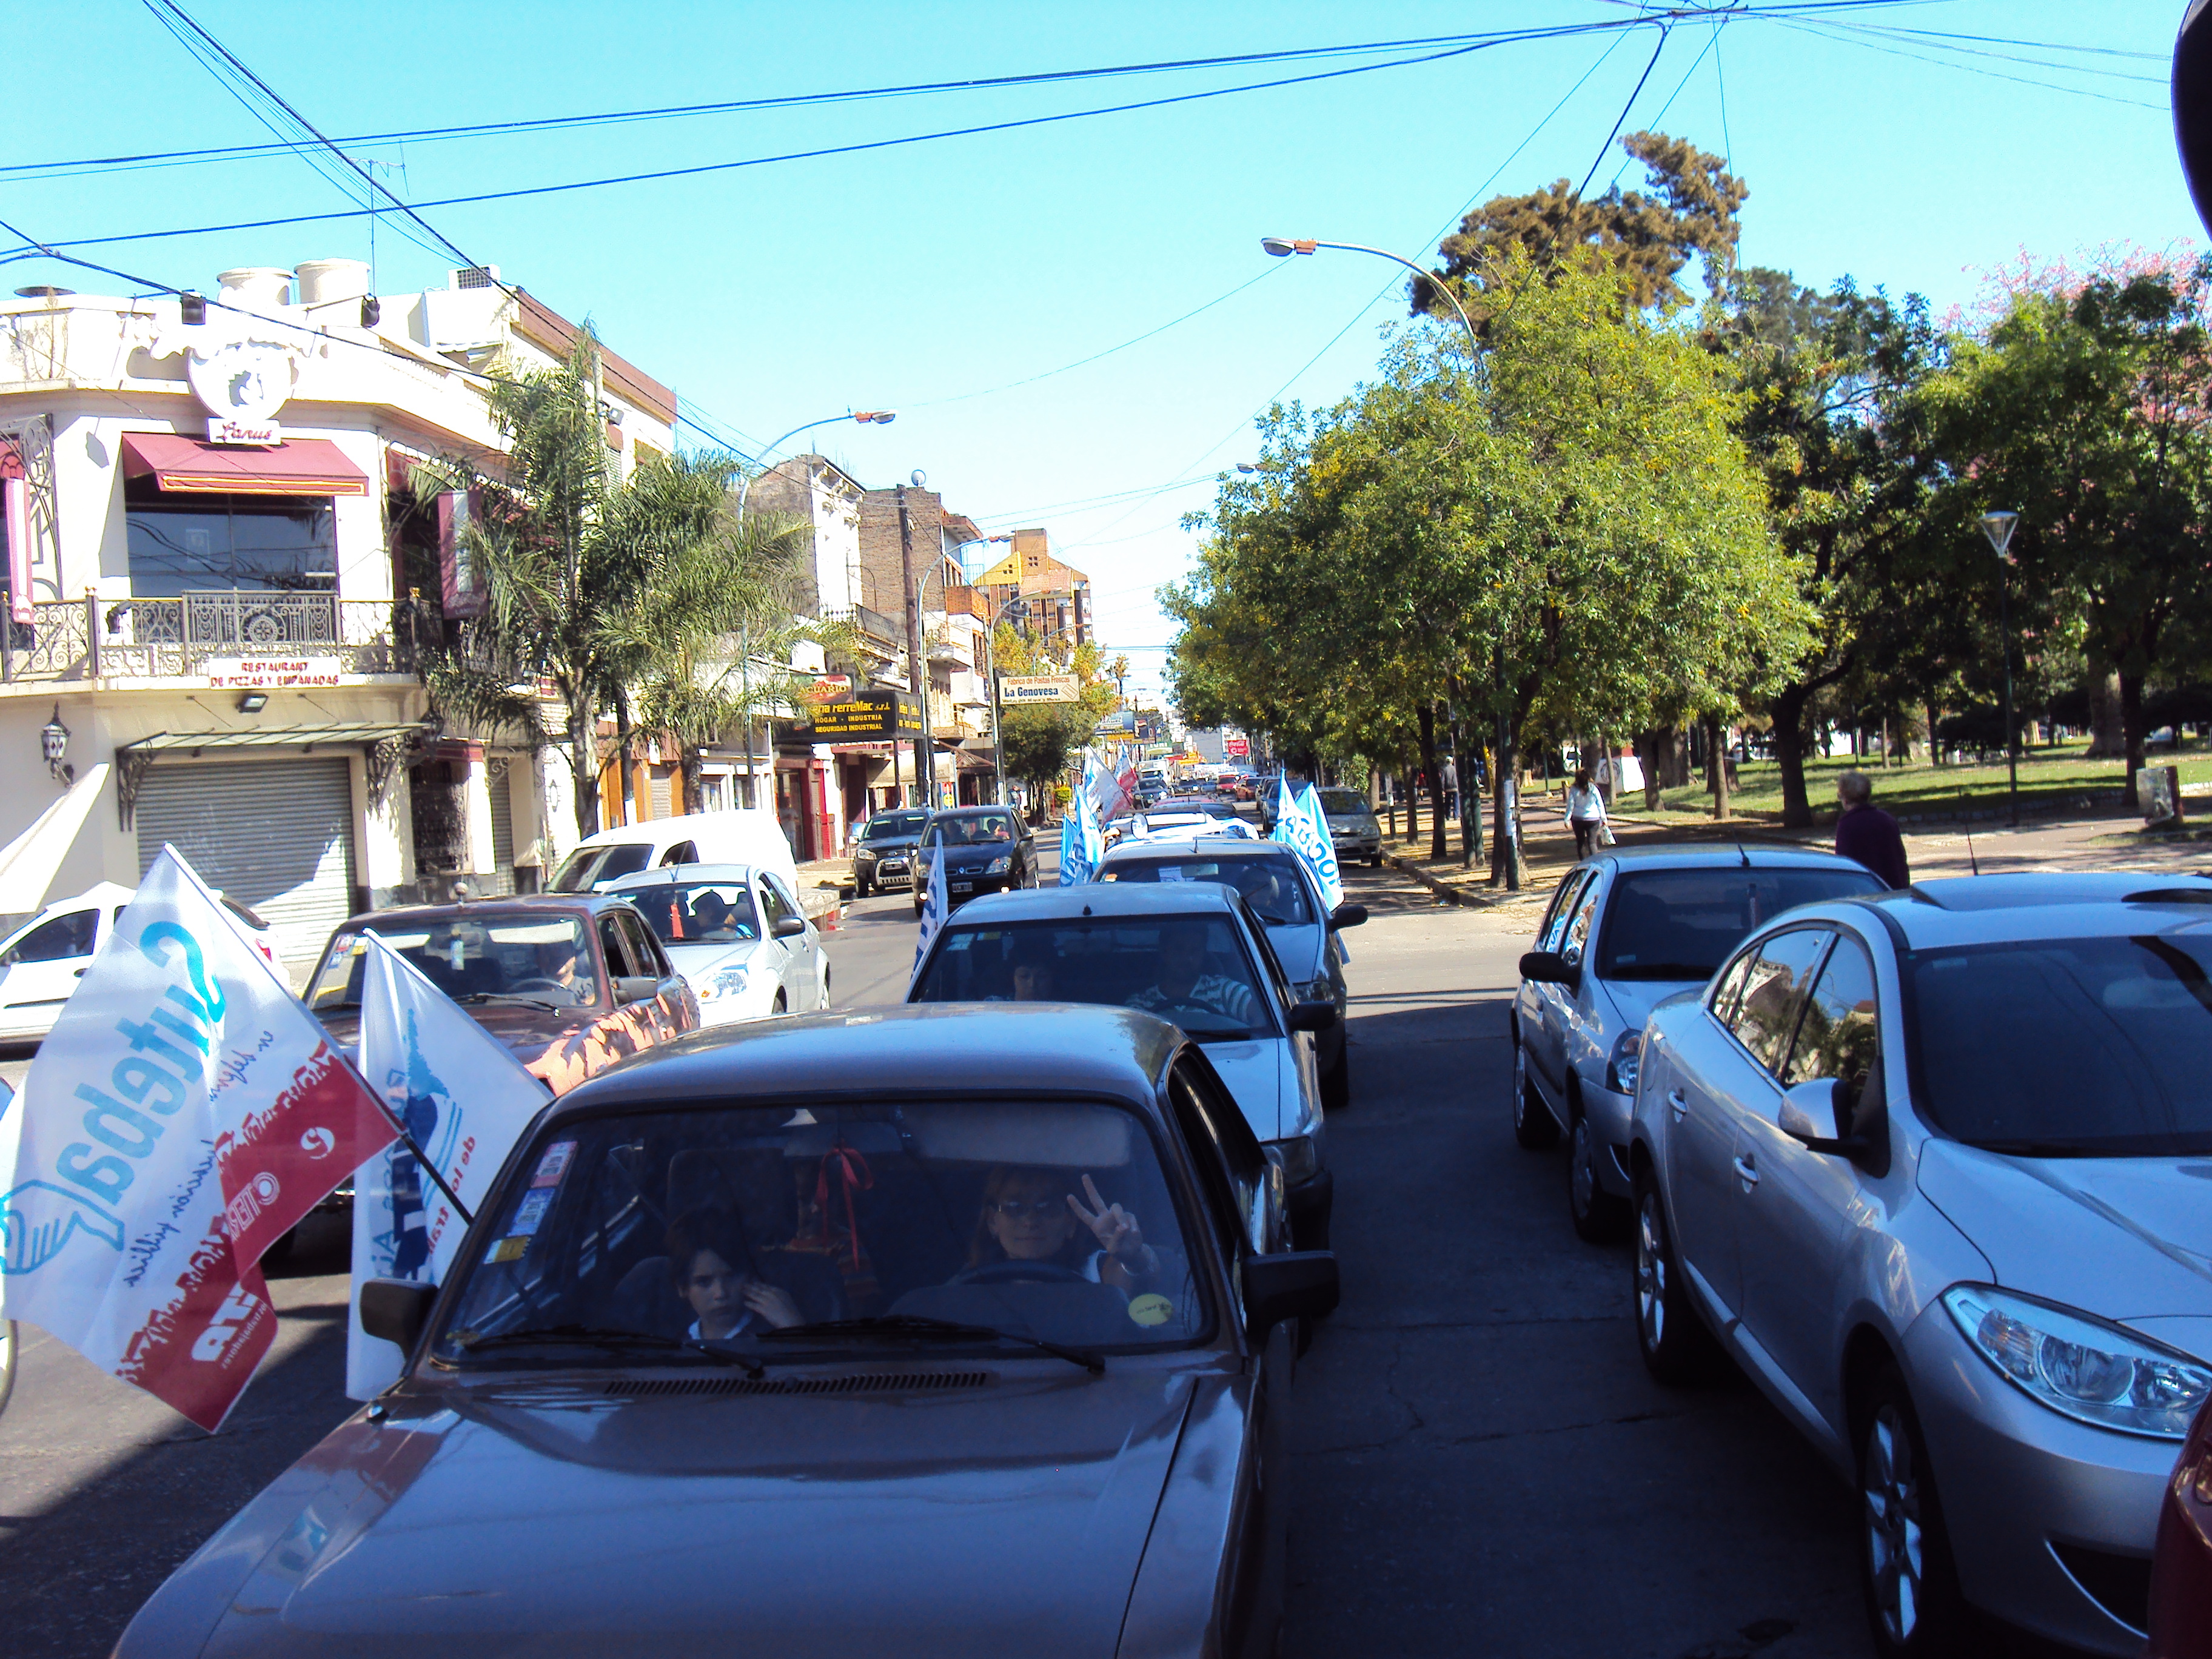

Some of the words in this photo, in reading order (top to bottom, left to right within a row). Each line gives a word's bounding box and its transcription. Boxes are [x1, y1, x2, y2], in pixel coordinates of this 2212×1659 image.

[241, 662, 309, 672] RESTAURANT
[210, 677, 223, 686] DE
[229, 676, 263, 686] PIZZAS
[267, 675, 272, 685] Y
[277, 675, 338, 686] EMPANADAS
[1051, 675, 1070, 684] Frescas
[800, 685, 847, 694] ACUARIO
[1004, 687, 1014, 697] La
[1017, 687, 1058, 697] Genovesa
